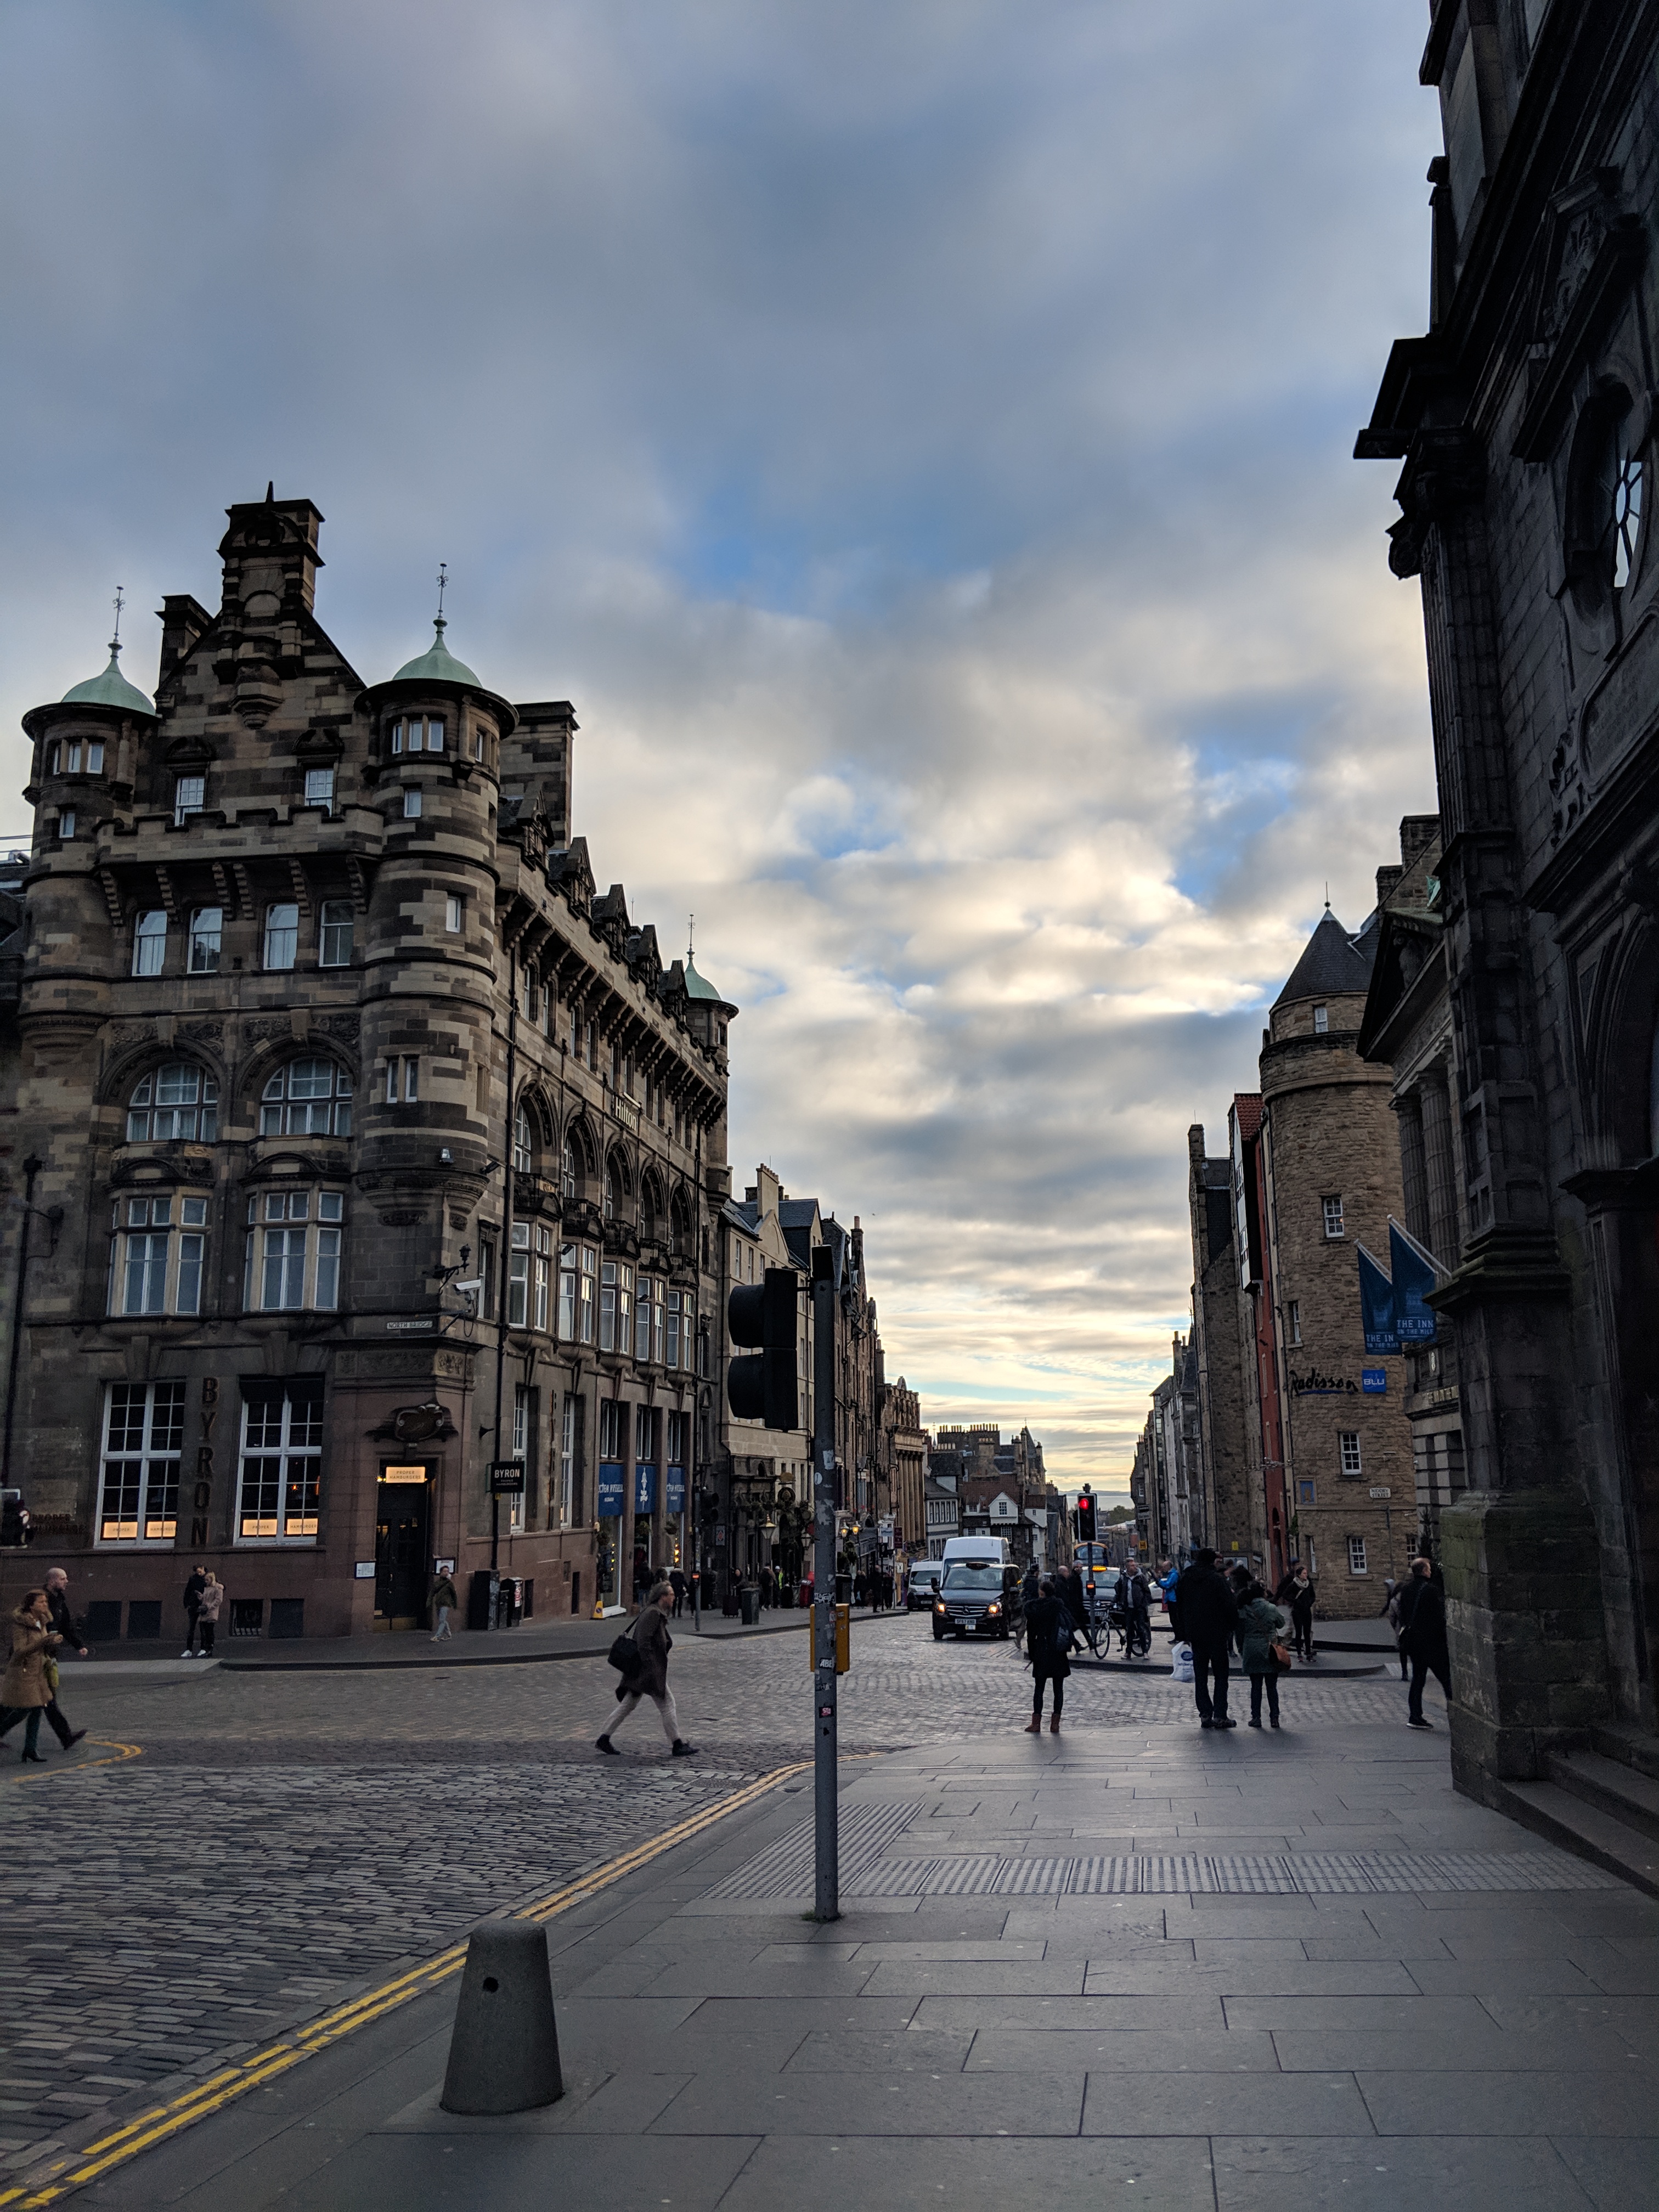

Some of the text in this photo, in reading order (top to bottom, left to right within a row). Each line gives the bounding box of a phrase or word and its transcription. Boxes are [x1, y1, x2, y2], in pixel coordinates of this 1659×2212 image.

[615, 1096, 637, 1131] Hilton
[1397, 1319, 1434, 1328] THE INN
[1366, 1334, 1381, 1342] THE
[1289, 1367, 1358, 1400] Radisson
[191, 1376, 219, 1546] BYRON
[494, 1469, 521, 1479] BYRON
